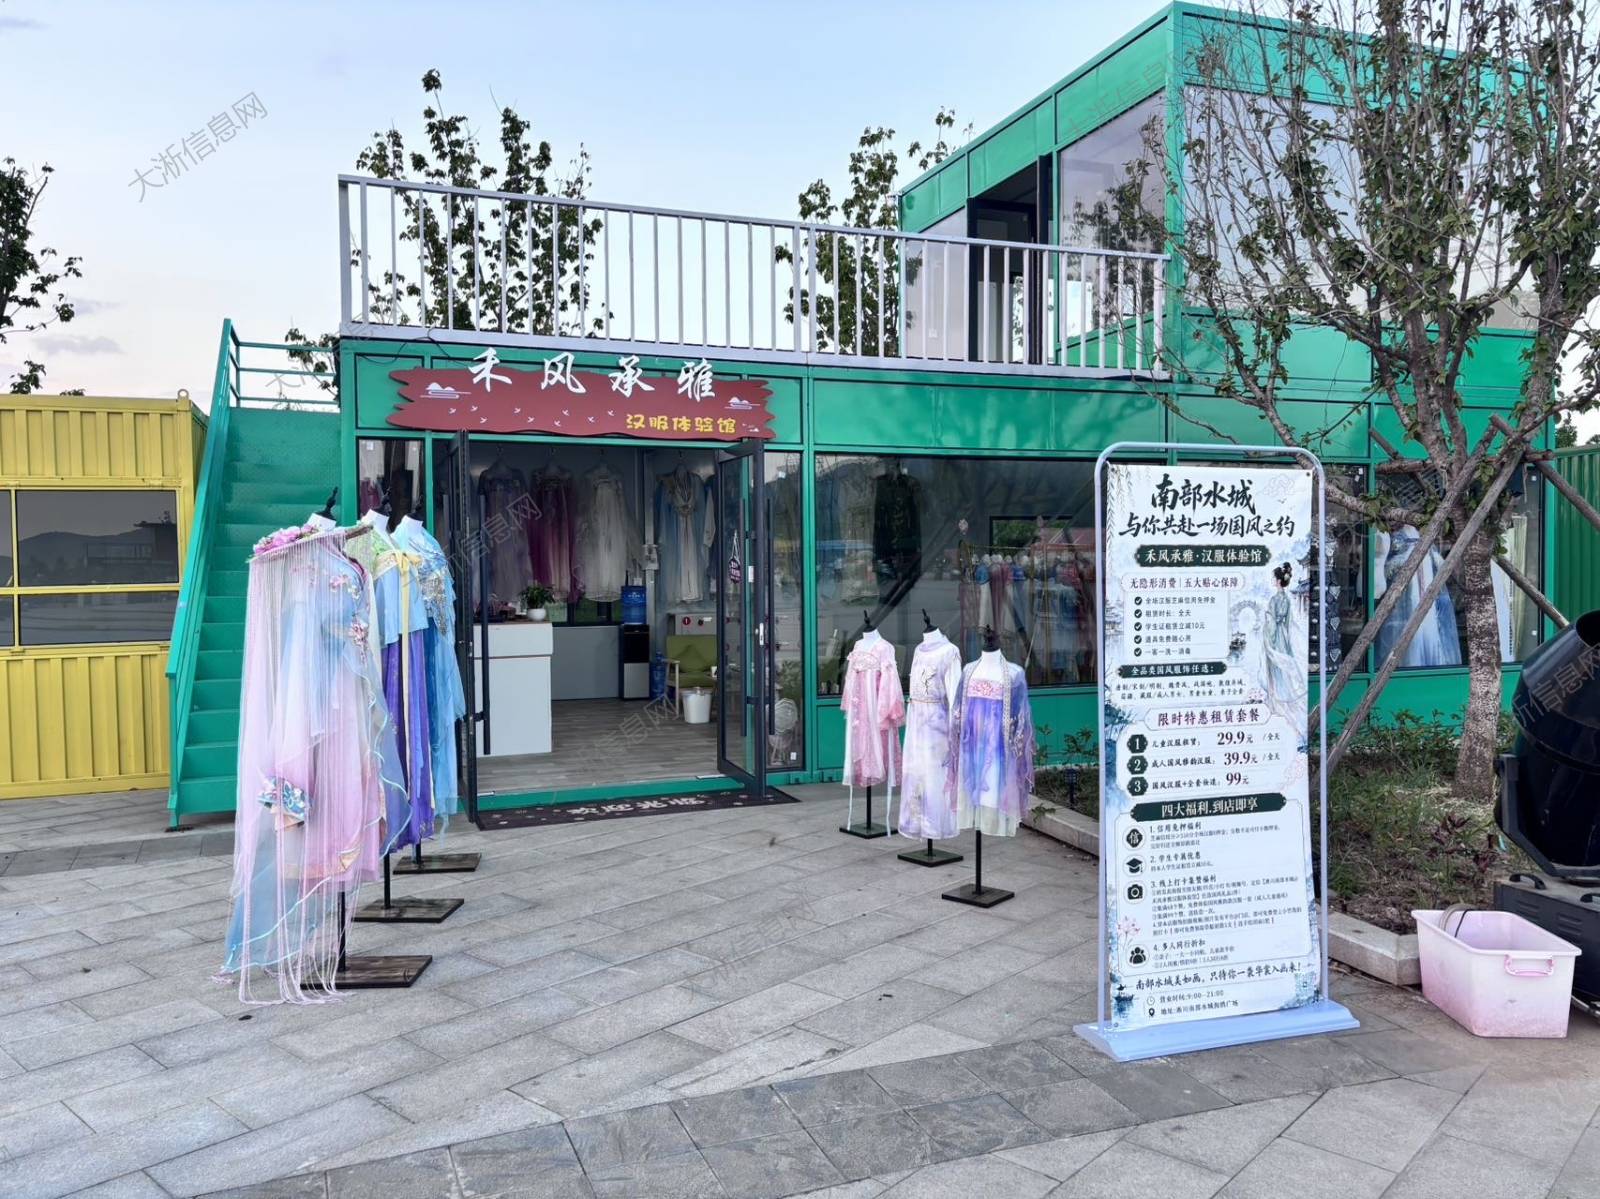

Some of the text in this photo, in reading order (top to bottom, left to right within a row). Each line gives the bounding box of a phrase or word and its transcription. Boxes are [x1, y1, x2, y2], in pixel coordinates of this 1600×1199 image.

[468, 347, 716, 402] 禾风承雅
[625, 413, 736, 434] 汉服体验馆
[1151, 473, 1256, 515] 南部水城
[1118, 512, 1295, 538] 与你共赴一场国风之约
[1158, 708, 1260, 727] 限时特惠租赁套餐
